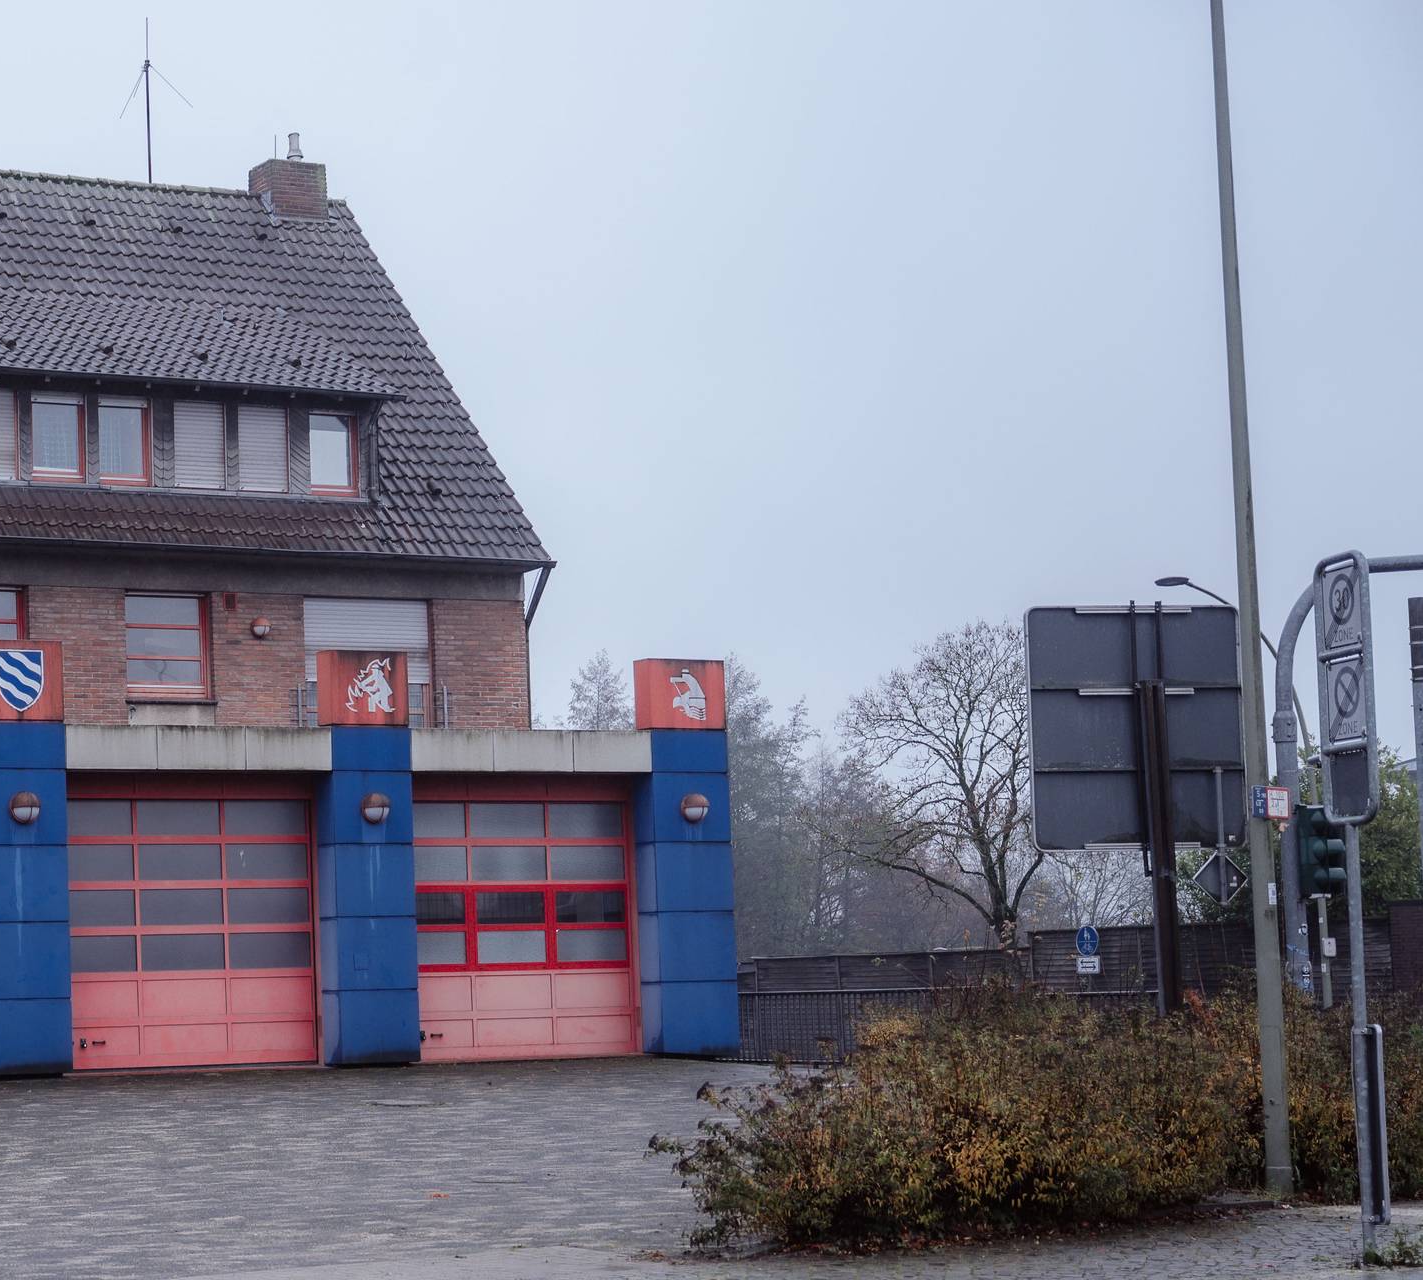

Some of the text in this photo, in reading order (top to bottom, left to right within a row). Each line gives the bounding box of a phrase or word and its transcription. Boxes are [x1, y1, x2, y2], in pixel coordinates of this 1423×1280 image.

[1334, 587, 1350, 613] 30
[1334, 627, 1354, 642] ZONE
[1338, 720, 1358, 736] ZONE
